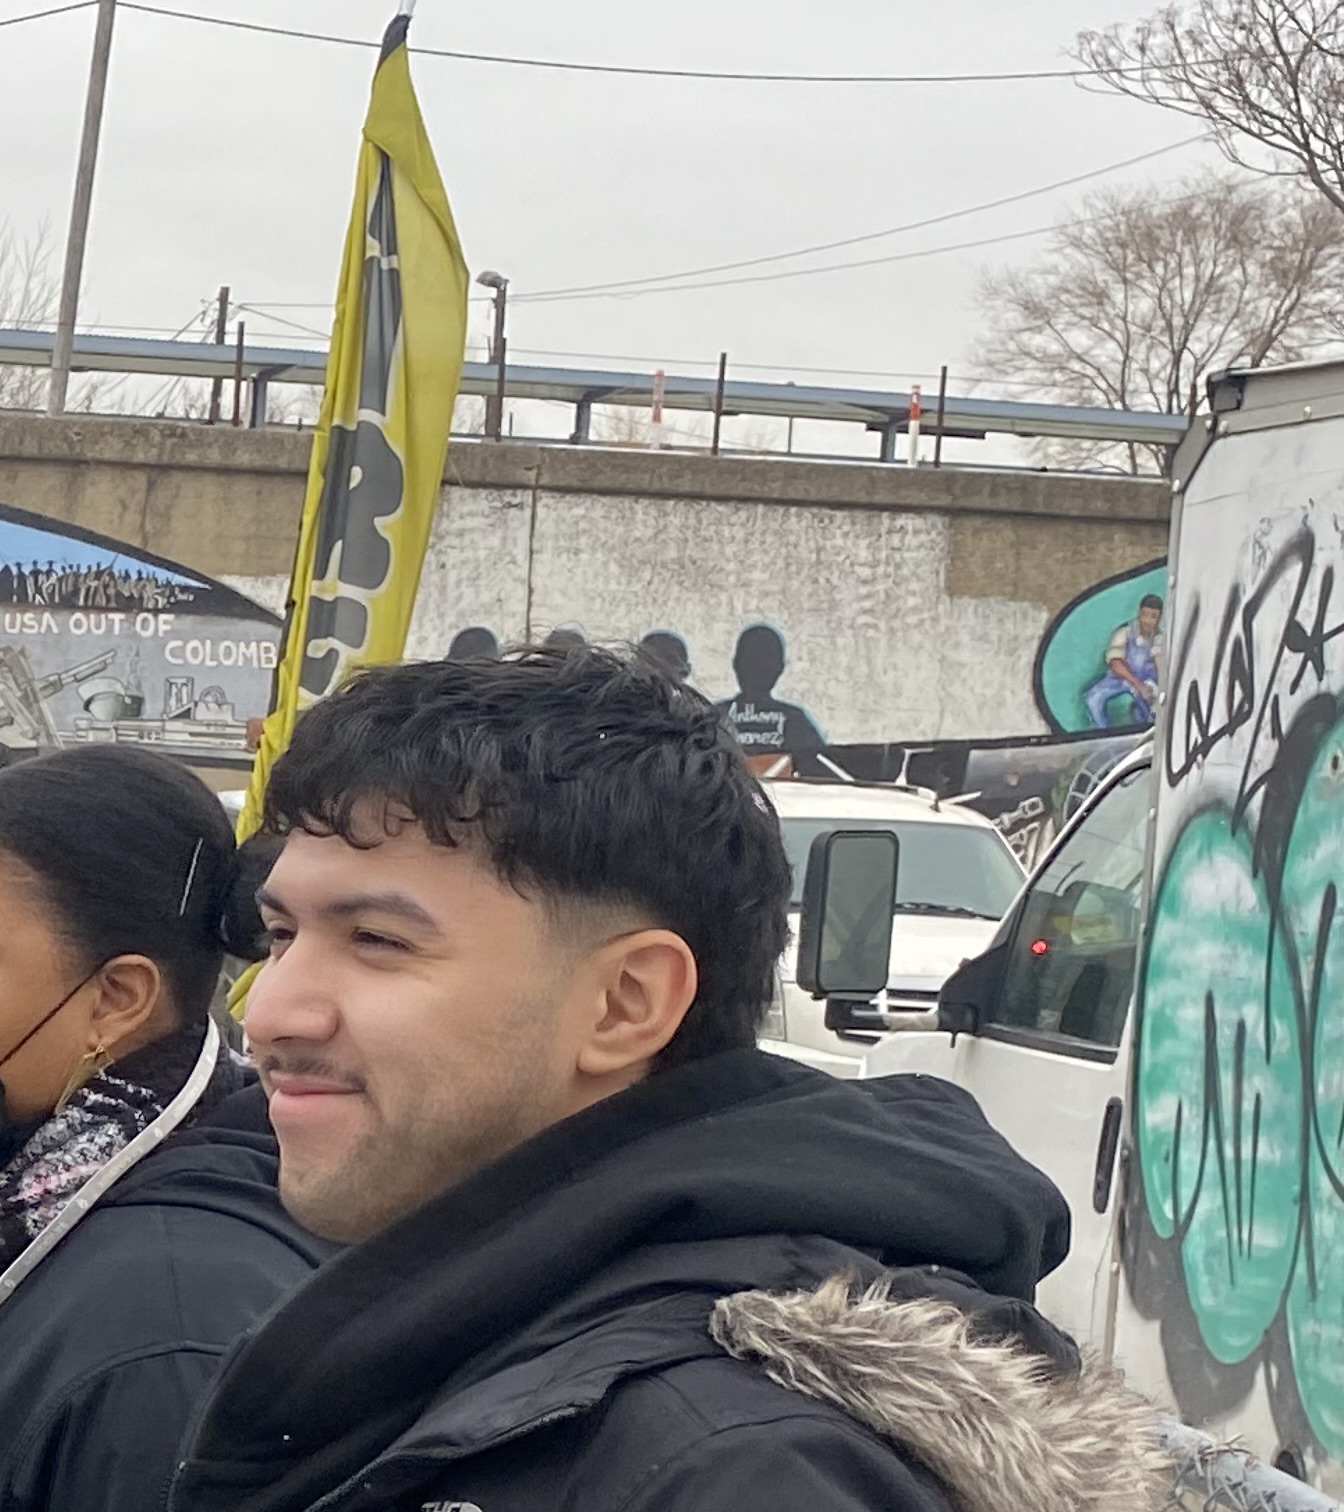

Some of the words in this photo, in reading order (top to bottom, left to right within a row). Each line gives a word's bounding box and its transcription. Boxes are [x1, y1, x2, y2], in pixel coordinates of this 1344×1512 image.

[4, 612, 60, 634] USA
[69, 612, 125, 635] OUT
[135, 612, 176, 637] OF
